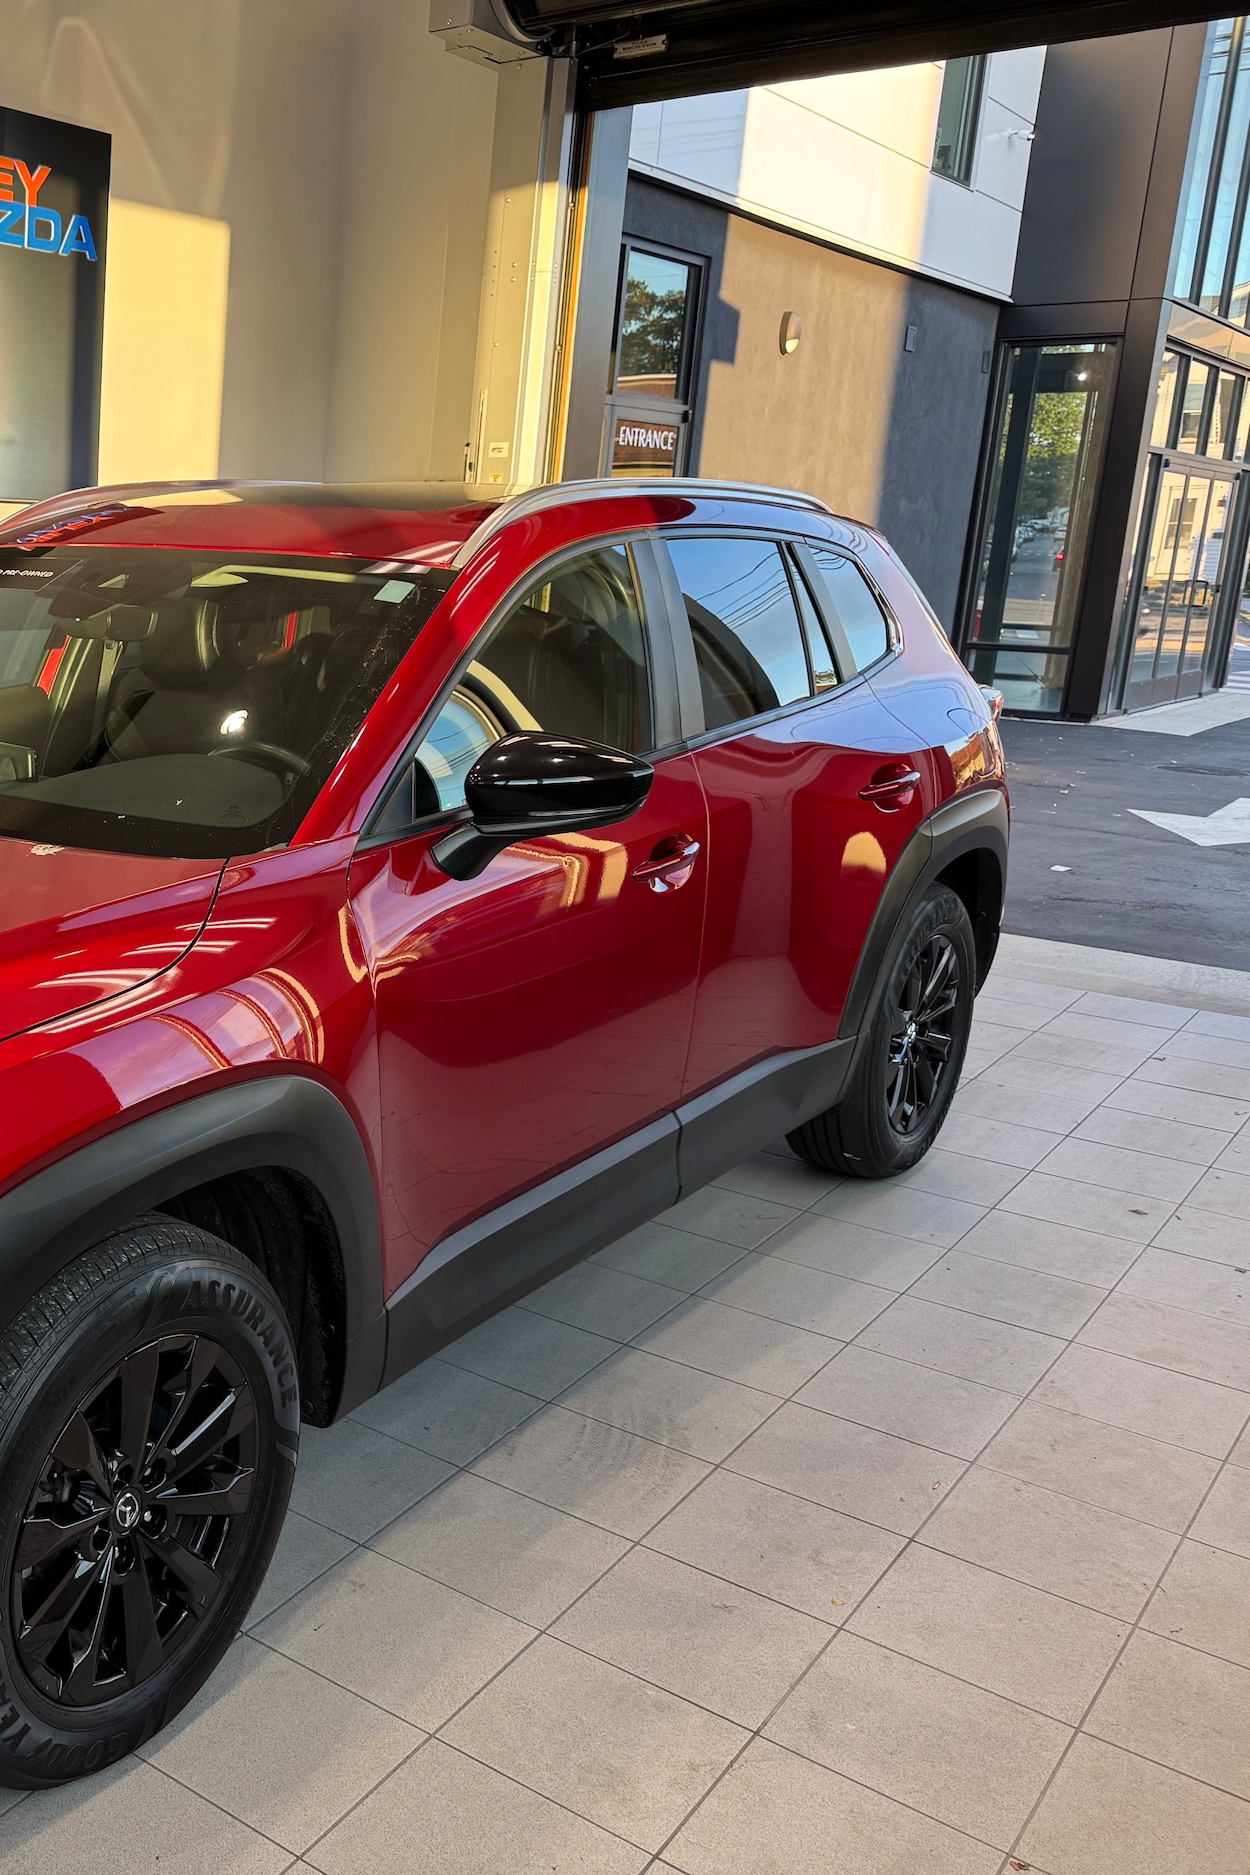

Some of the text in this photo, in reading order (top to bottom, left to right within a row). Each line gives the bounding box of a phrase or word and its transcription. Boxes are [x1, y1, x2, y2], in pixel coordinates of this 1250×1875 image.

[618, 426, 674, 451] ENTRANCE
[2, 569, 54, 578] PRE-OWNED
[180, 1280, 297, 1408] ASSURANCE
